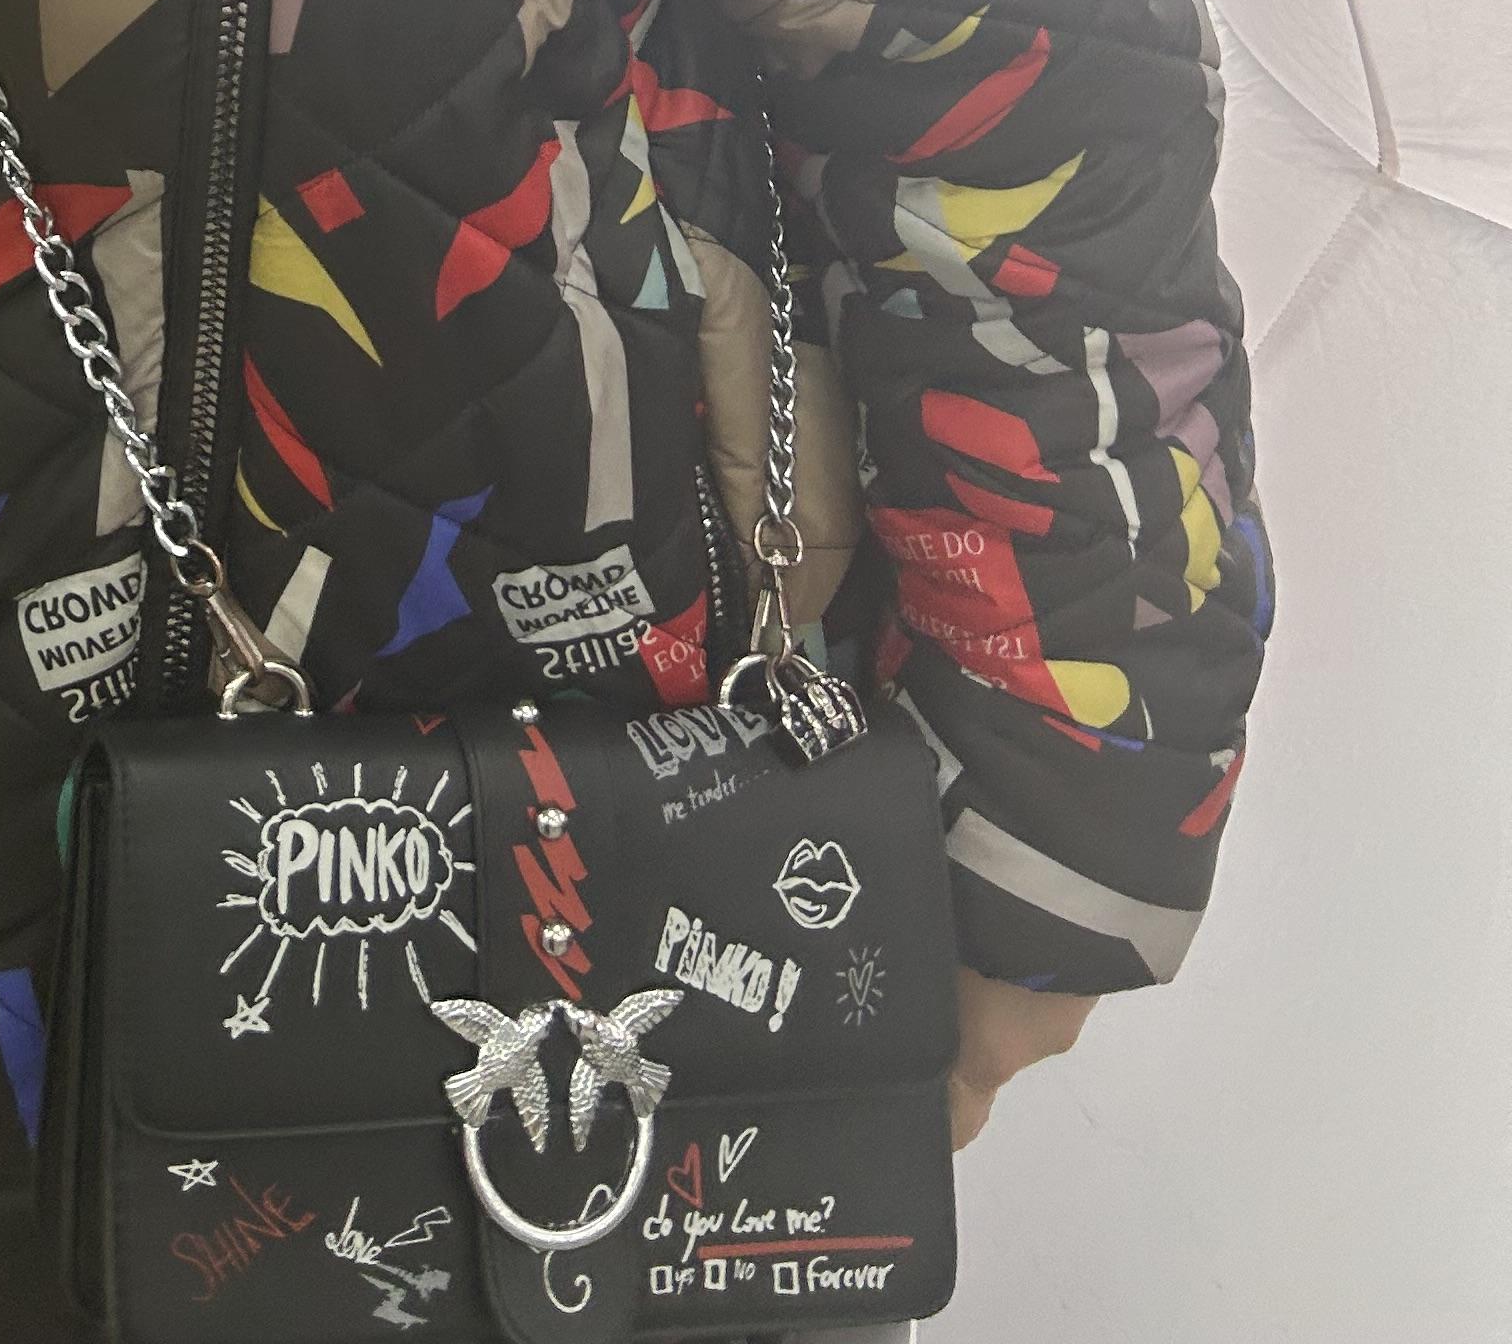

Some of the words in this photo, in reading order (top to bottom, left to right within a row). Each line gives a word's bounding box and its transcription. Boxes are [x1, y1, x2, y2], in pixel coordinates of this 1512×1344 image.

[276, 818, 430, 914] PINKO
[642, 1194, 674, 1240] do
[682, 1209, 724, 1263] you
